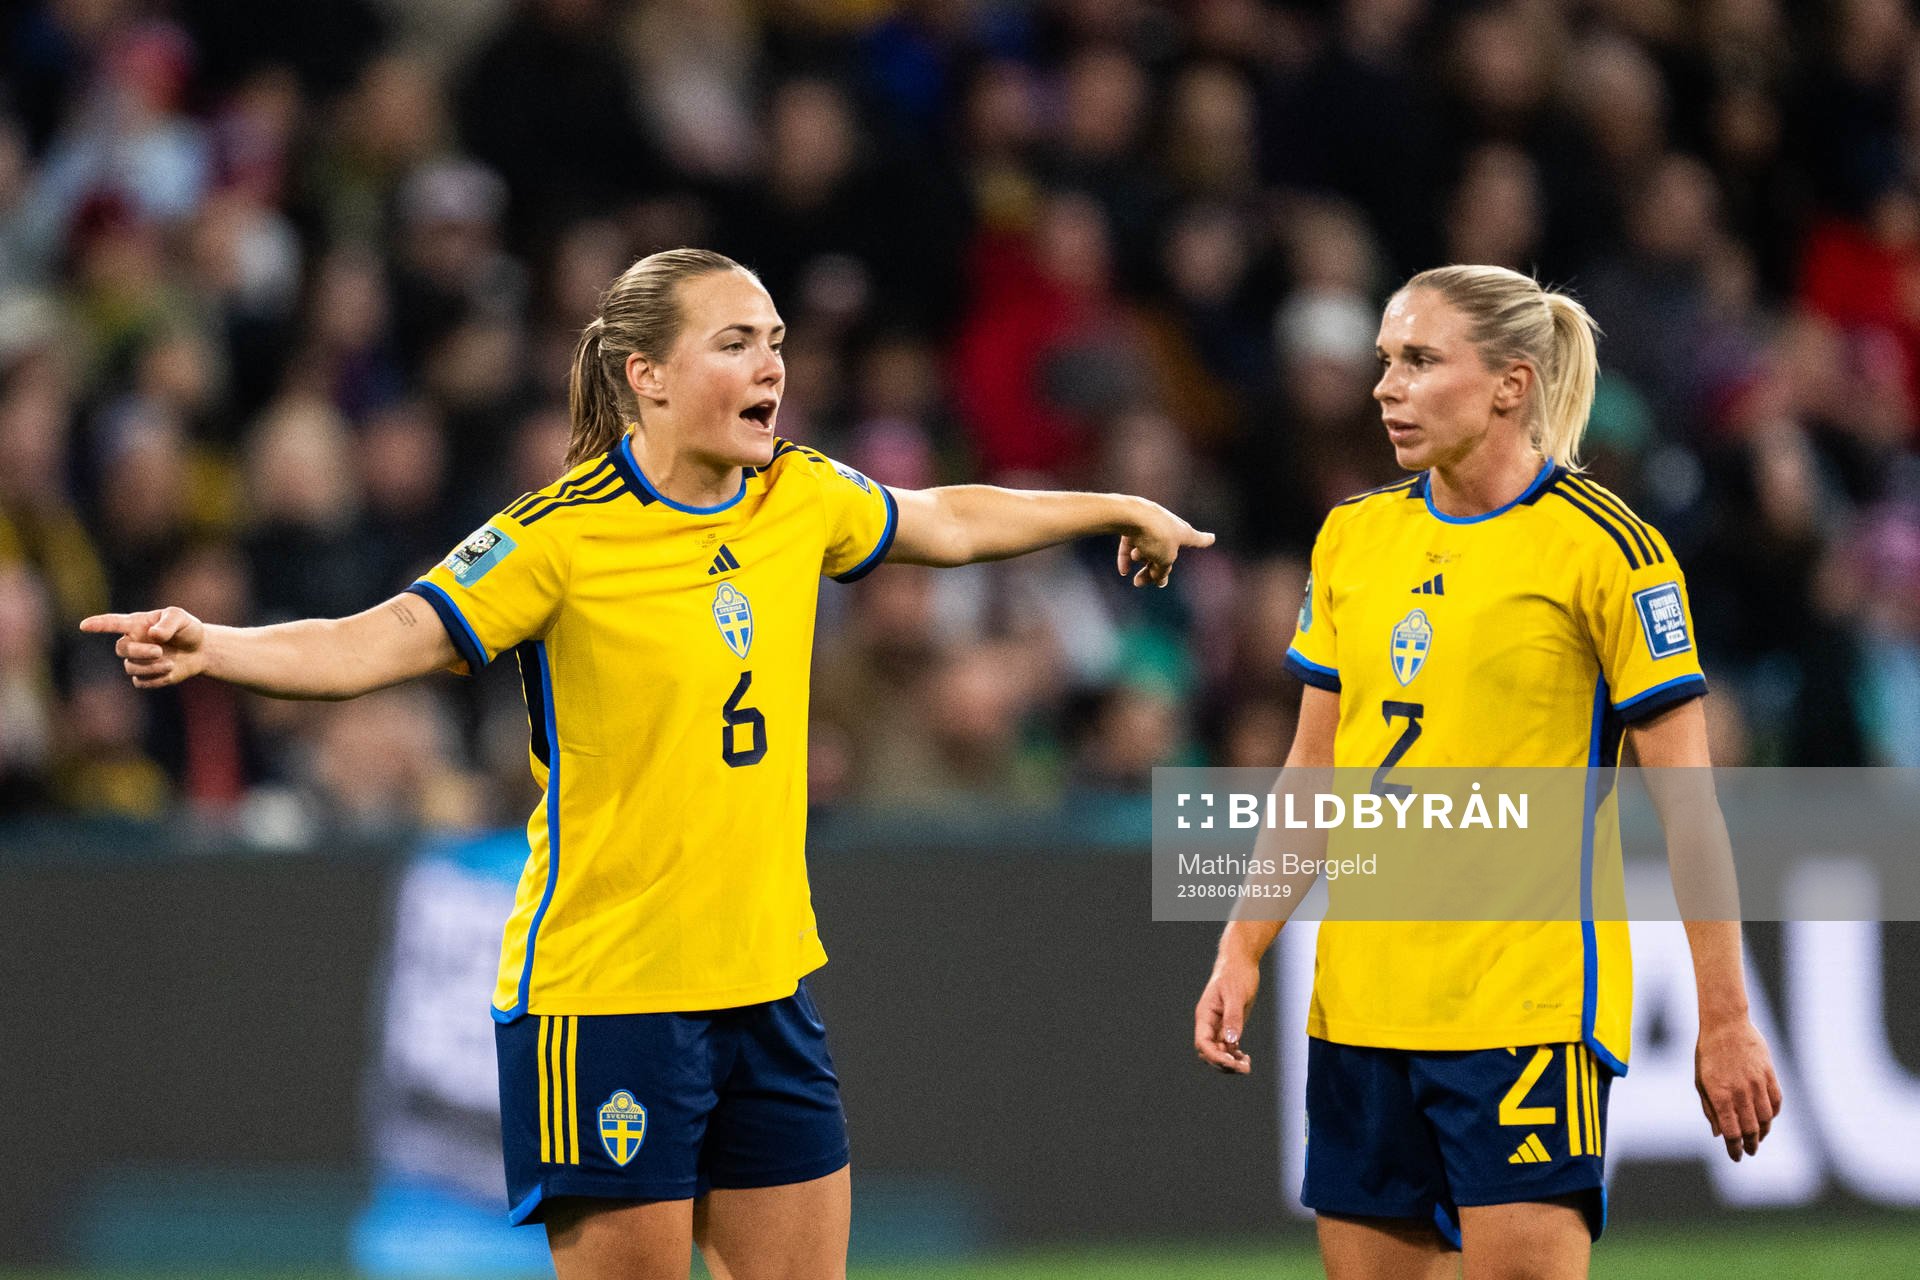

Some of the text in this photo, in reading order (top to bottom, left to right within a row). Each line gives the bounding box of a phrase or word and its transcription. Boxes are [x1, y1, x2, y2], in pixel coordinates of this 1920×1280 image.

[722, 670, 768, 768] 6
[1369, 699, 1424, 800] 2
[1499, 1044, 1556, 1126] 2
